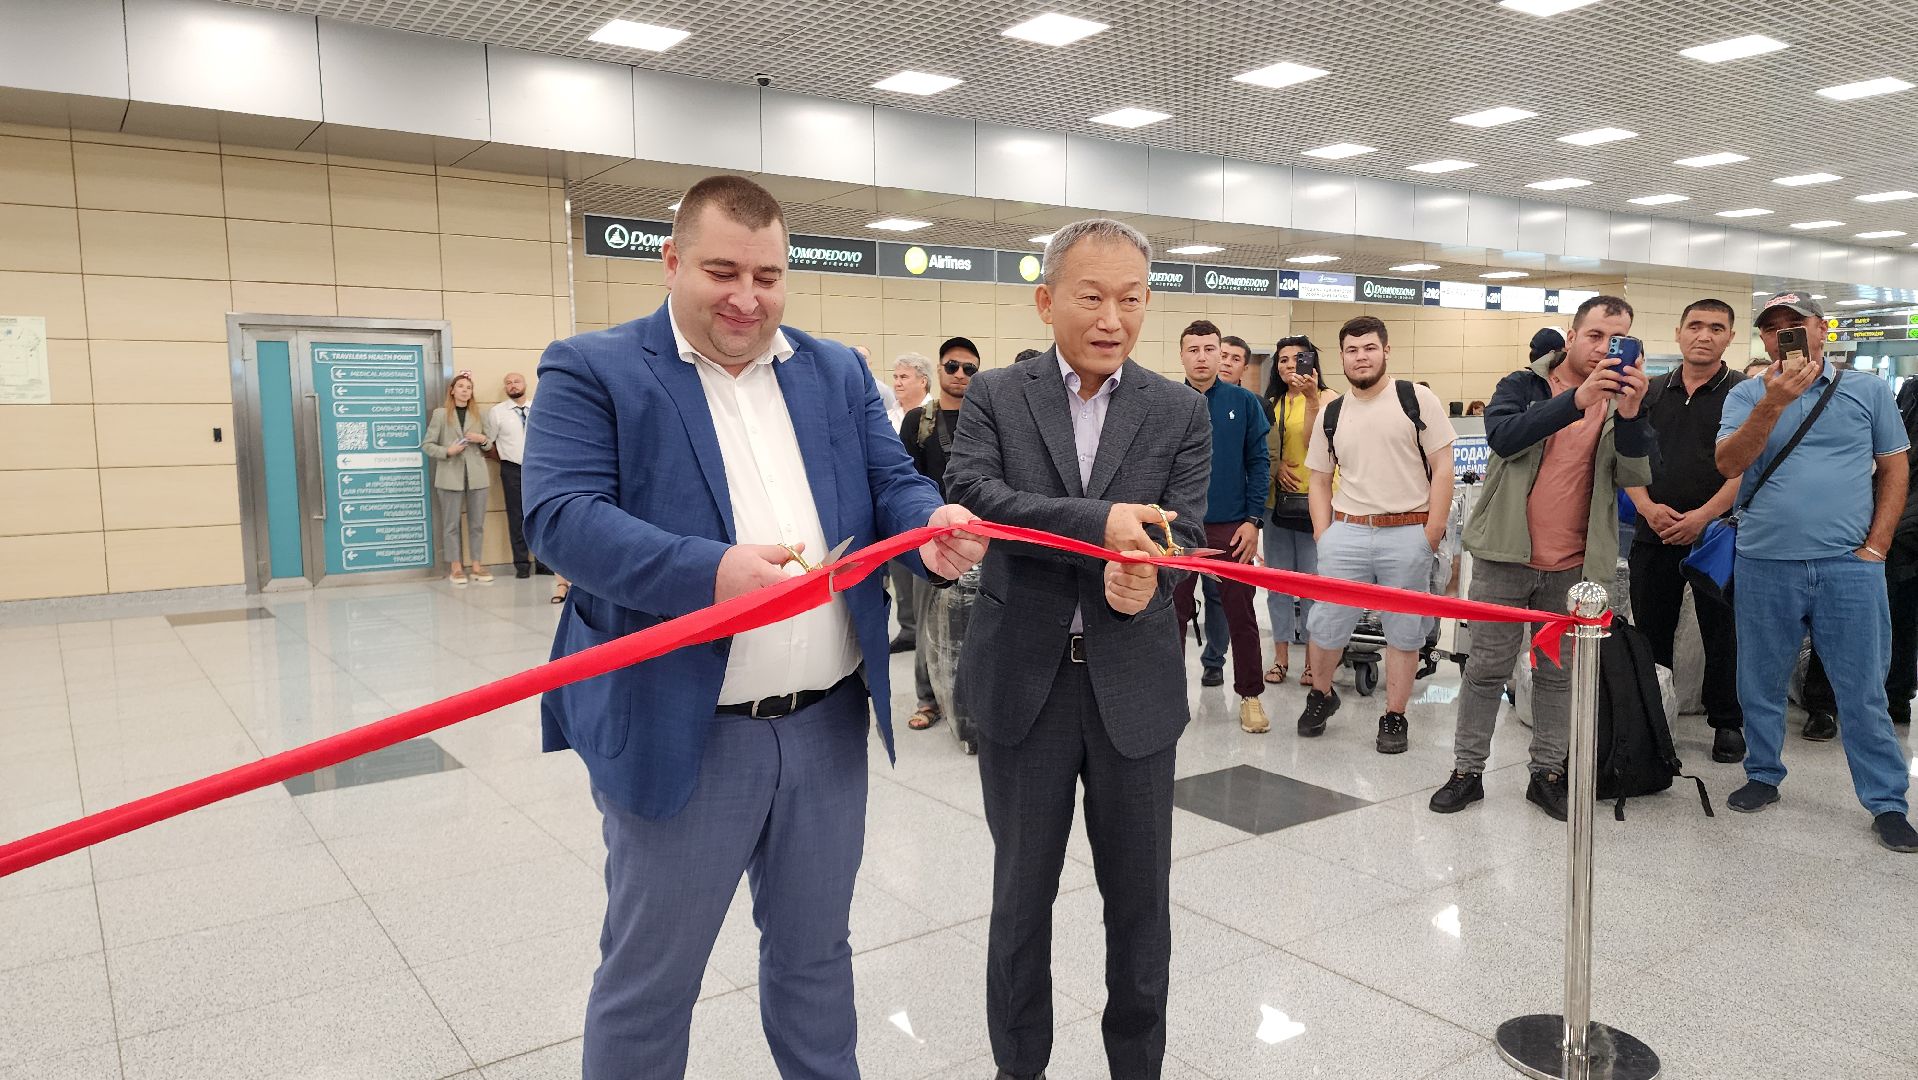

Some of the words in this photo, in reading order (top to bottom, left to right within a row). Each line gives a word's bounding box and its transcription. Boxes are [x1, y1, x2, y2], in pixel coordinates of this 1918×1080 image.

[928, 254, 972, 270] Airlines
[1219, 275, 1269, 287] DOMODEDOVO
[1454, 446, 1491, 464] РОДАЖ
